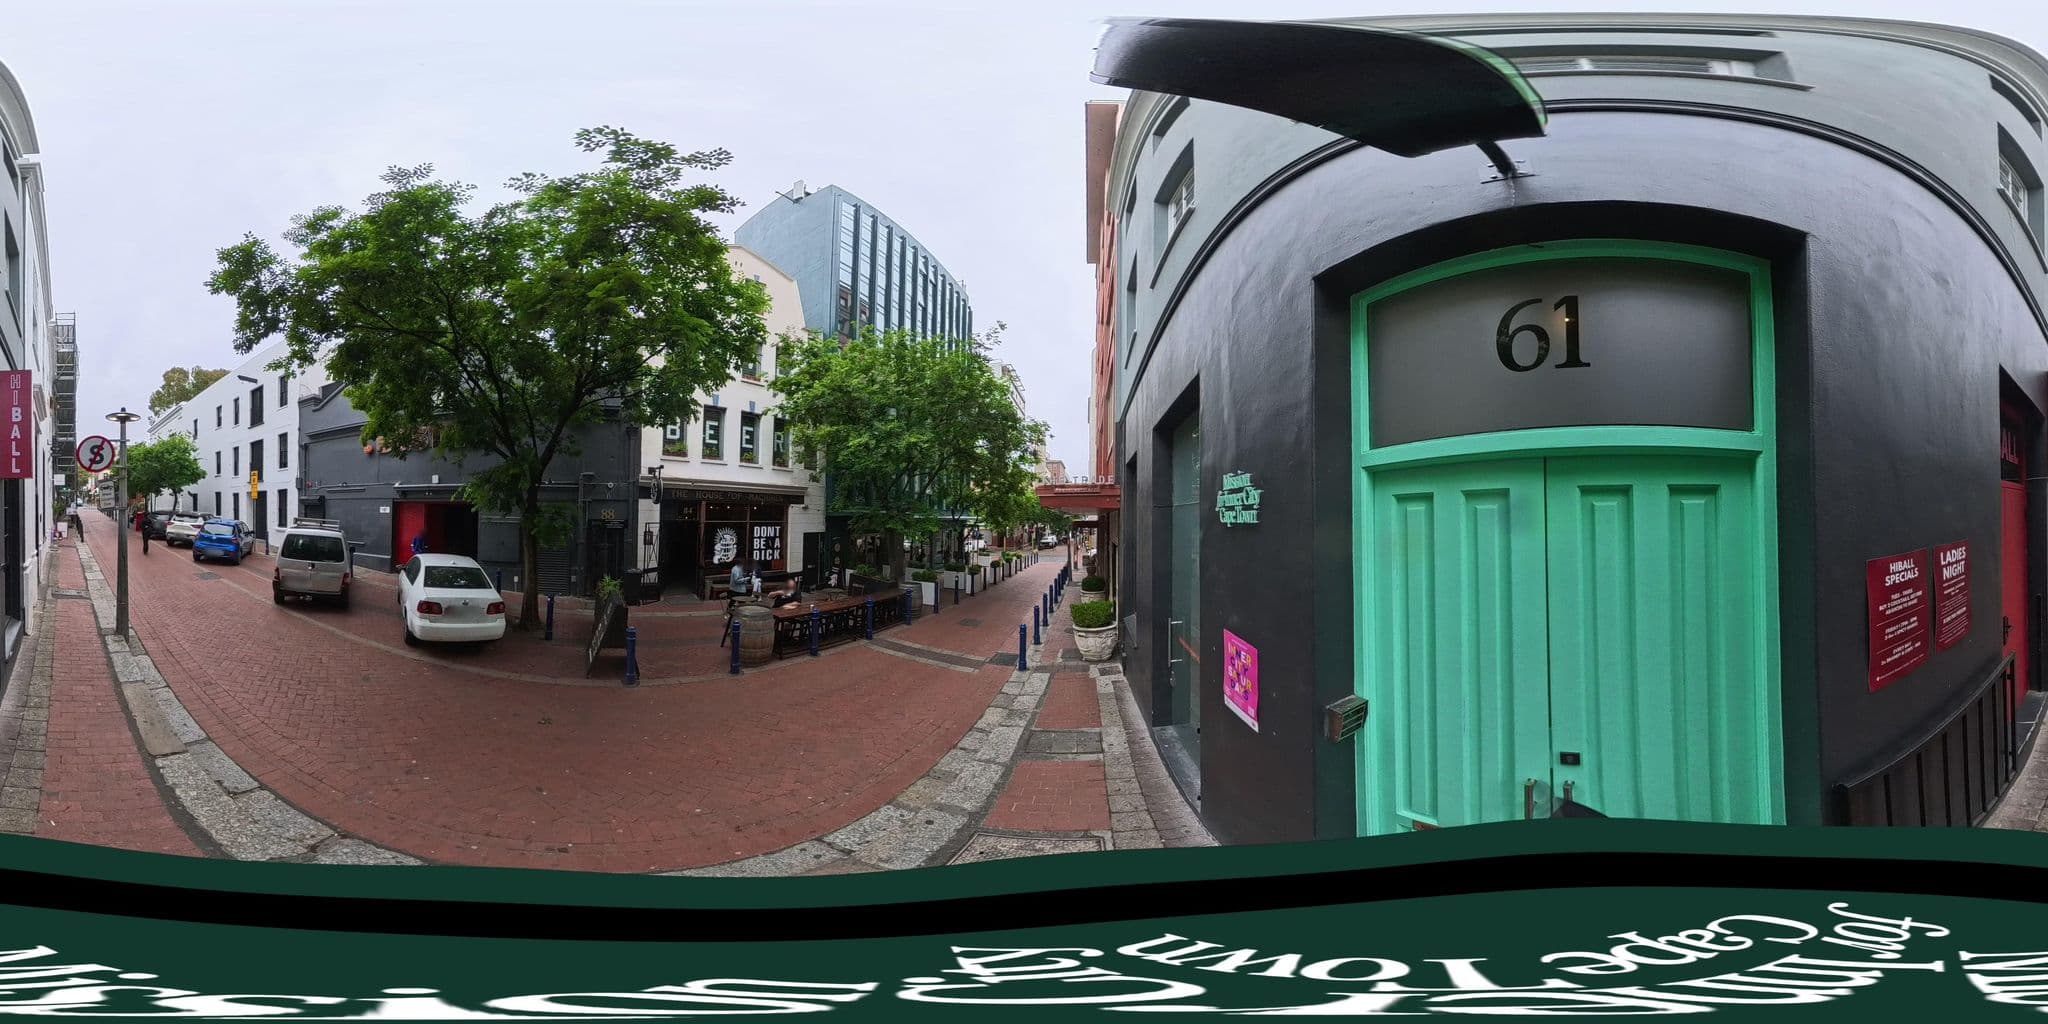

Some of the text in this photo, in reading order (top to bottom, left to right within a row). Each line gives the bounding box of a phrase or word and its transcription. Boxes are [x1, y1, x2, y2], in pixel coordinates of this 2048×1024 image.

[1496, 295, 1591, 373] 61
[10, 374, 22, 473] HIBALL
[1223, 470, 1253, 491] Mission
[671, 489, 689, 499] THE
[696, 490, 724, 500] HOUSE
[601, 509, 615, 520] 88
[1219, 505, 1260, 528] Cape Town
[753, 526, 781, 537] DONT
[753, 538, 781, 549] BE A
[753, 549, 780, 561] DICK
[1940, 546, 1966, 566] LADIES
[1889, 558, 1915, 573] HIBALL
[1943, 559, 1966, 580] NIGHT
[1885, 567, 1919, 586] SPECIALS
[1228, 642, 1252, 668] INNER
[1230, 656, 1250, 675] CITY
